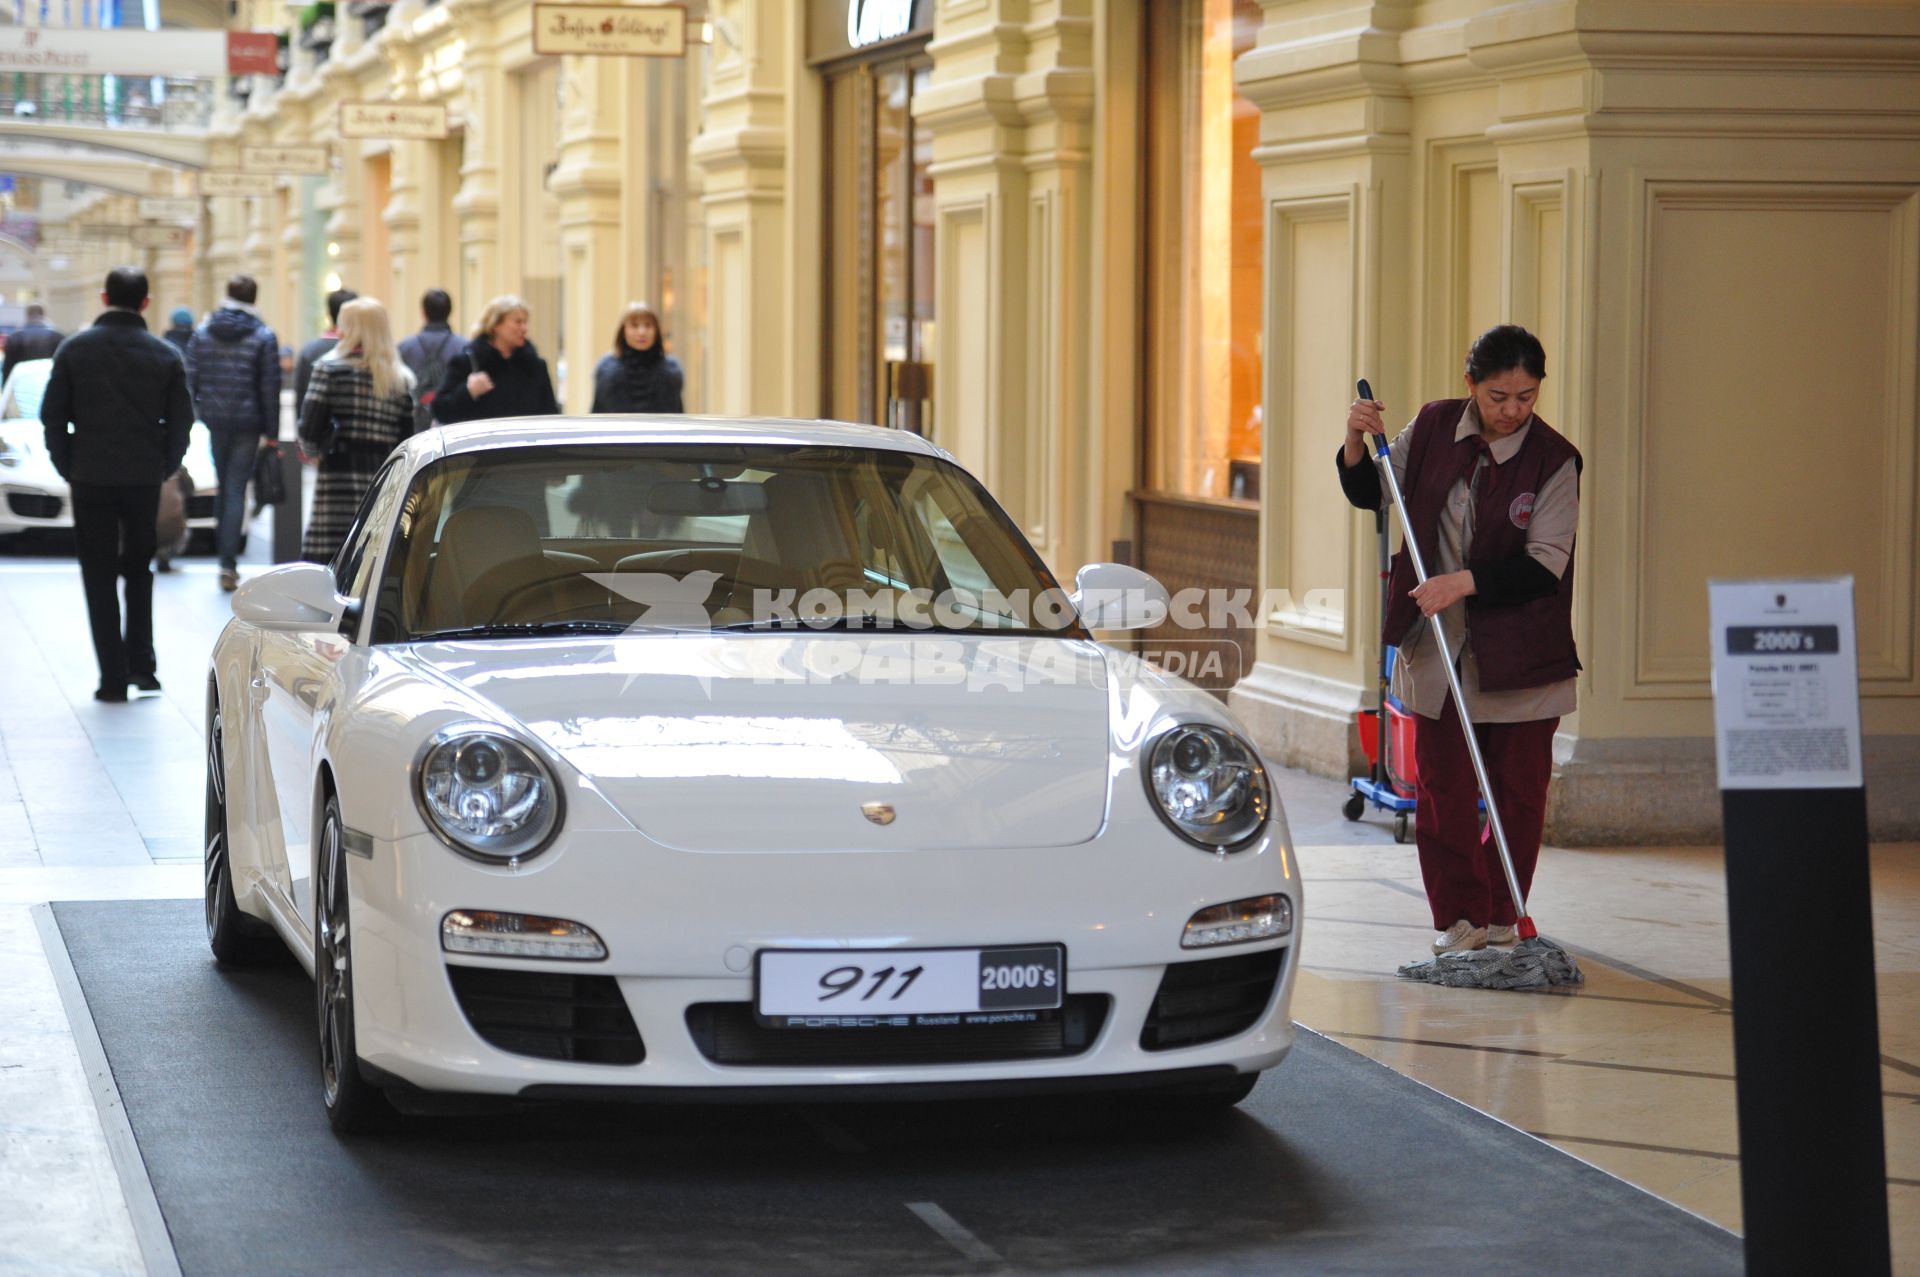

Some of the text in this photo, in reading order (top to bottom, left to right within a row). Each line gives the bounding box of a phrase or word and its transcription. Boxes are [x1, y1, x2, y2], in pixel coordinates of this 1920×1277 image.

[817, 965, 924, 1002] 911
[787, 1012, 1037, 1027] PORSCHE Russland www.porsche.ru
